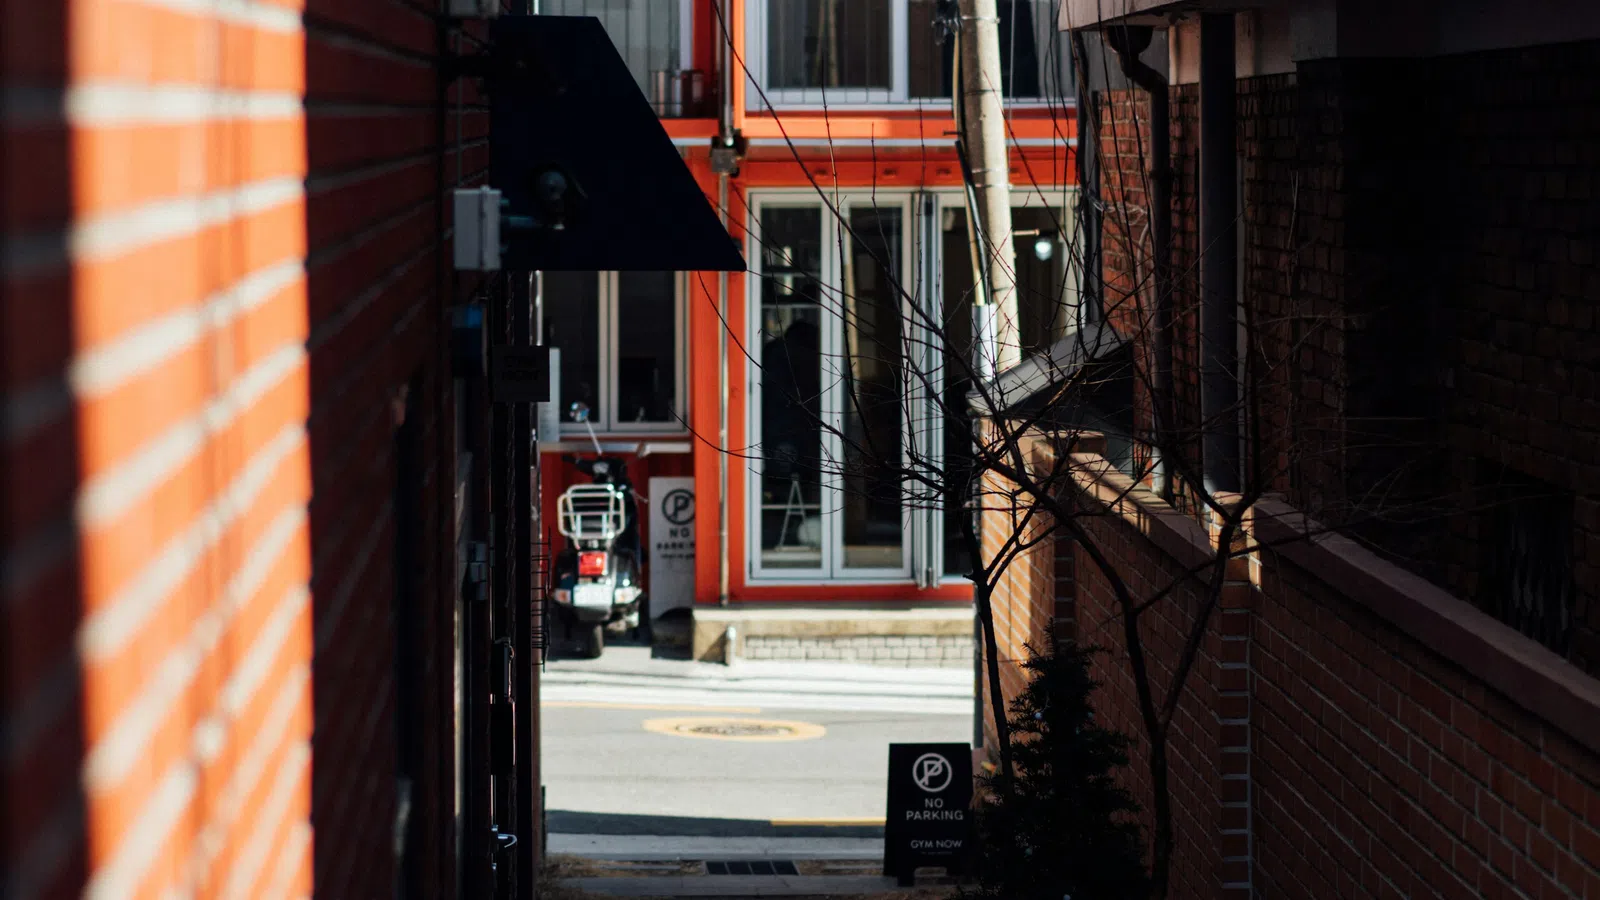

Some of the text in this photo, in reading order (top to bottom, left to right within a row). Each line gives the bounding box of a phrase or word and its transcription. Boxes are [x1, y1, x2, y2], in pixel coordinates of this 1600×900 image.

[924, 798, 943, 808] NO
[906, 810, 964, 820] PARKING
[910, 839, 962, 849] GYM NOW
